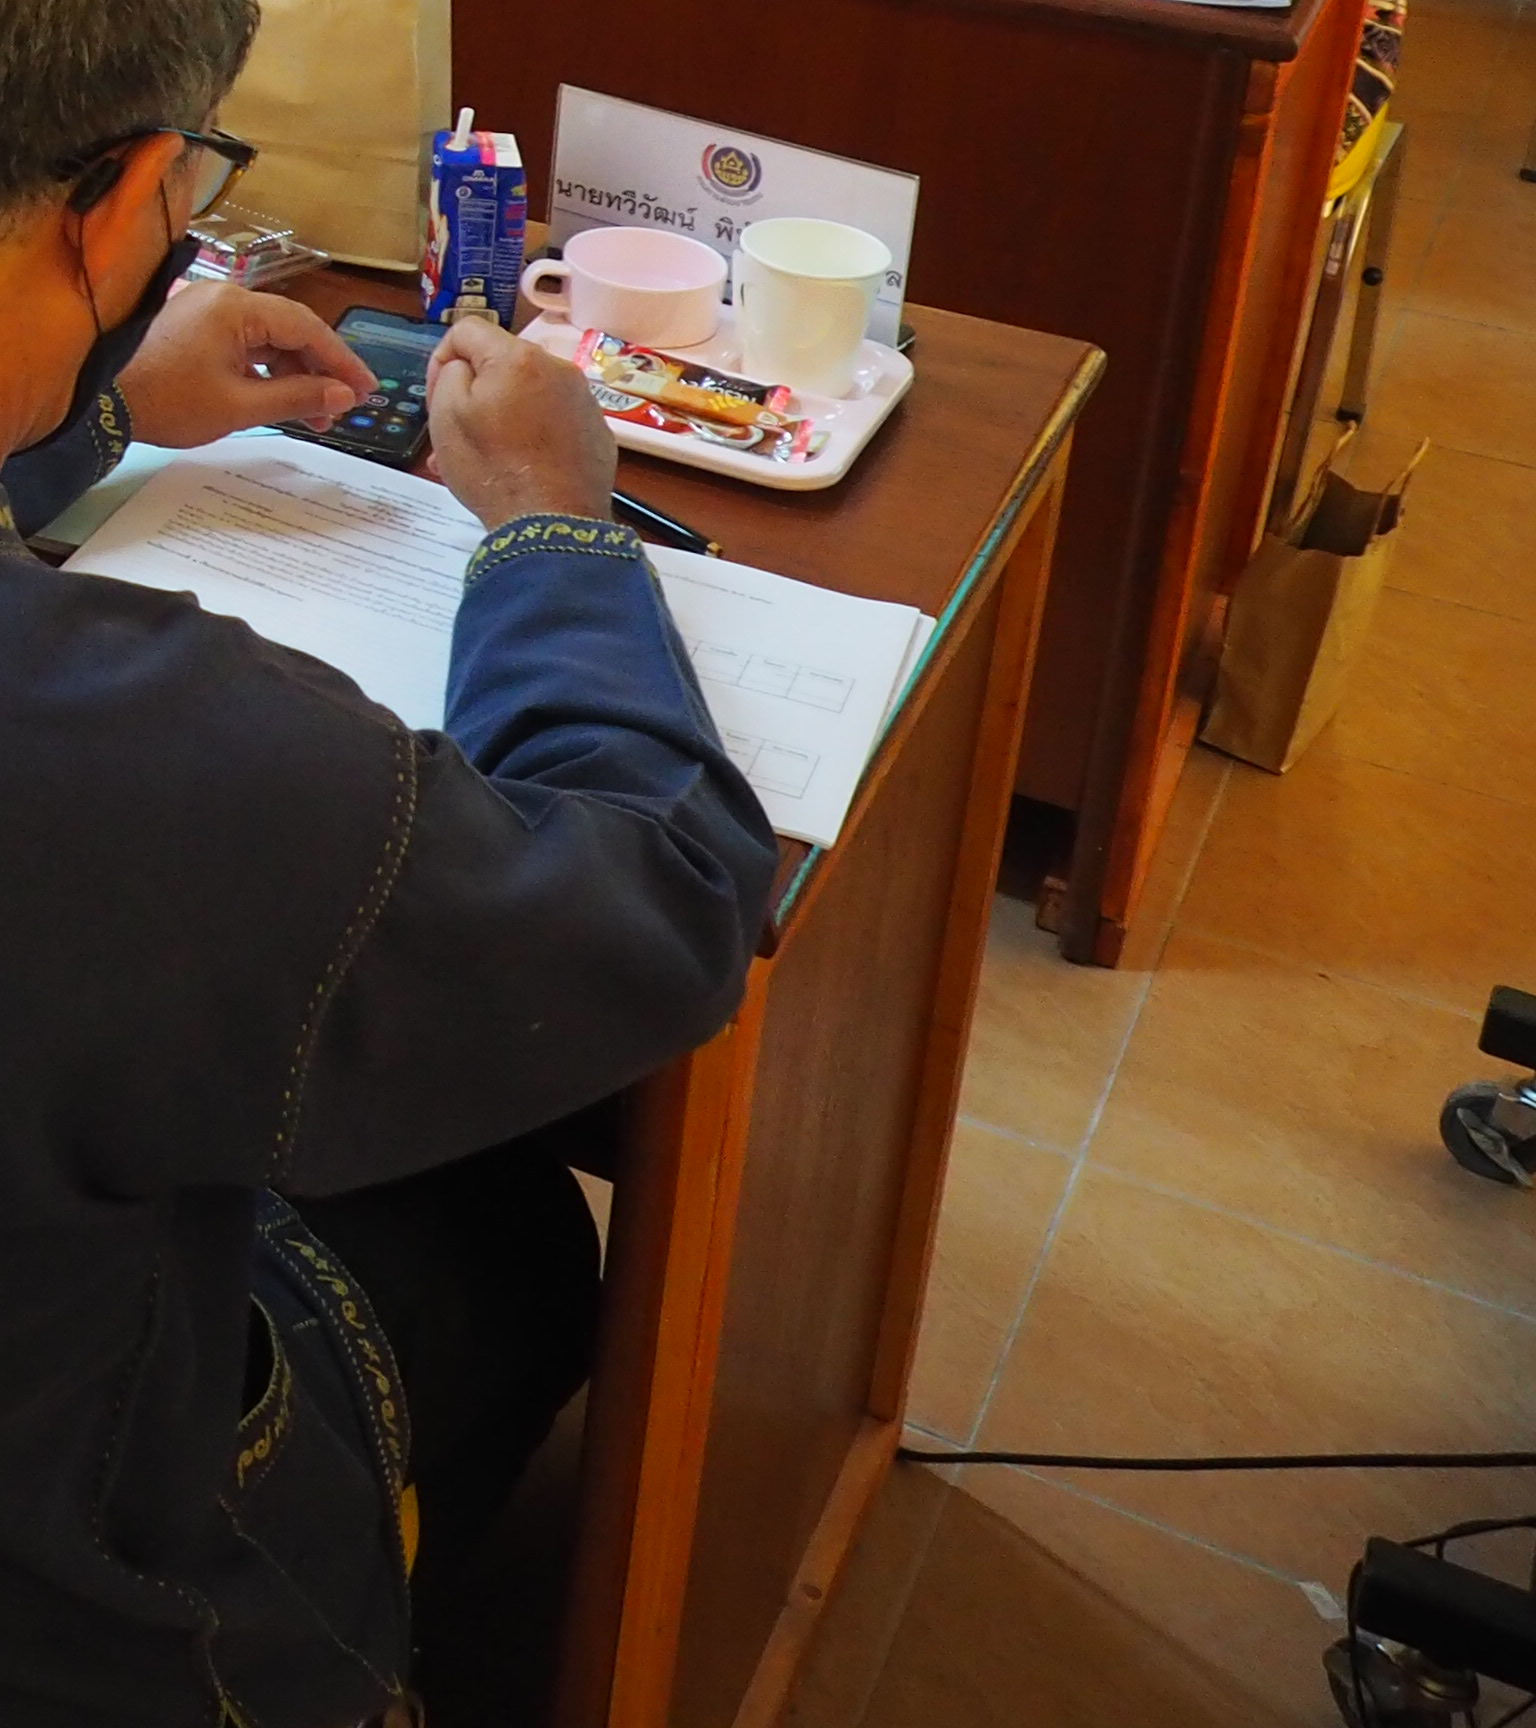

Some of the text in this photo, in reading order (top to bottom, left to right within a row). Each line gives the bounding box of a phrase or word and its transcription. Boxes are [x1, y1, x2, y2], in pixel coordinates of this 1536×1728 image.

[555, 177, 699, 232] นายทวีวัฒน์
